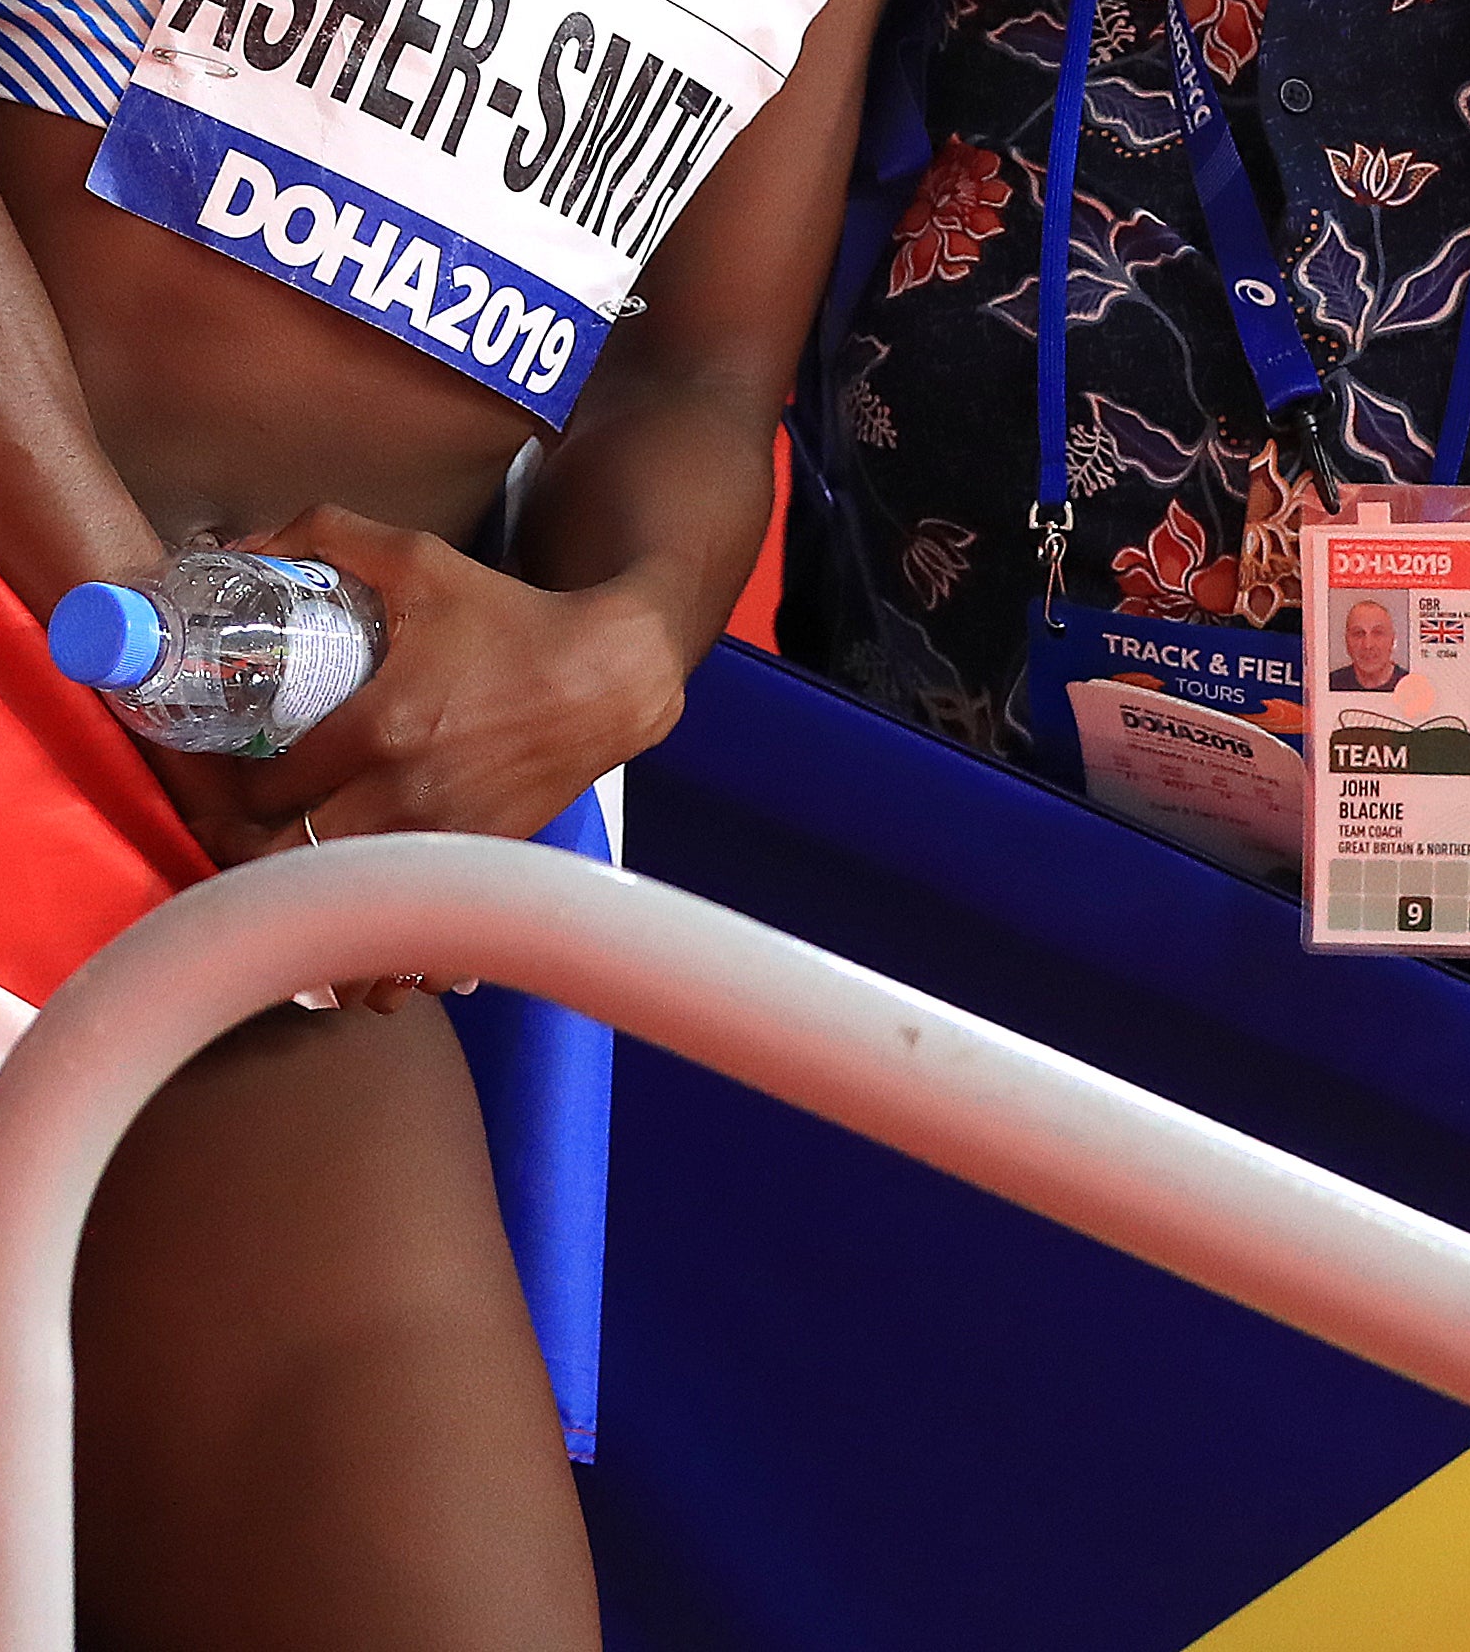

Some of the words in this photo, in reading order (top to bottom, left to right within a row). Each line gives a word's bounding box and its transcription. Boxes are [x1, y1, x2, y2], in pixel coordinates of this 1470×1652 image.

[196, 146, 579, 396] DOHA2019
[1332, 552, 1453, 576] DOHA2019
[1101, 632, 1201, 672] TRACK
[1208, 652, 1230, 677] &
[1237, 655, 1301, 687] FIEL
[1174, 676, 1246, 705] TOURS
[1120, 709, 1255, 759] DOHA2019
[1333, 743, 1409, 769] TEAM
[1338, 779, 1380, 798] JOHN
[1338, 801, 1405, 821] BLACKIE
[1337, 824, 1366, 838] TEAM
[1367, 824, 1403, 839] COACH
[1337, 840, 1370, 854] GREAT
[1372, 841, 1414, 856] BRITAIN
[1416, 842, 1424, 855] &
[1406, 902, 1424, 927] 9
